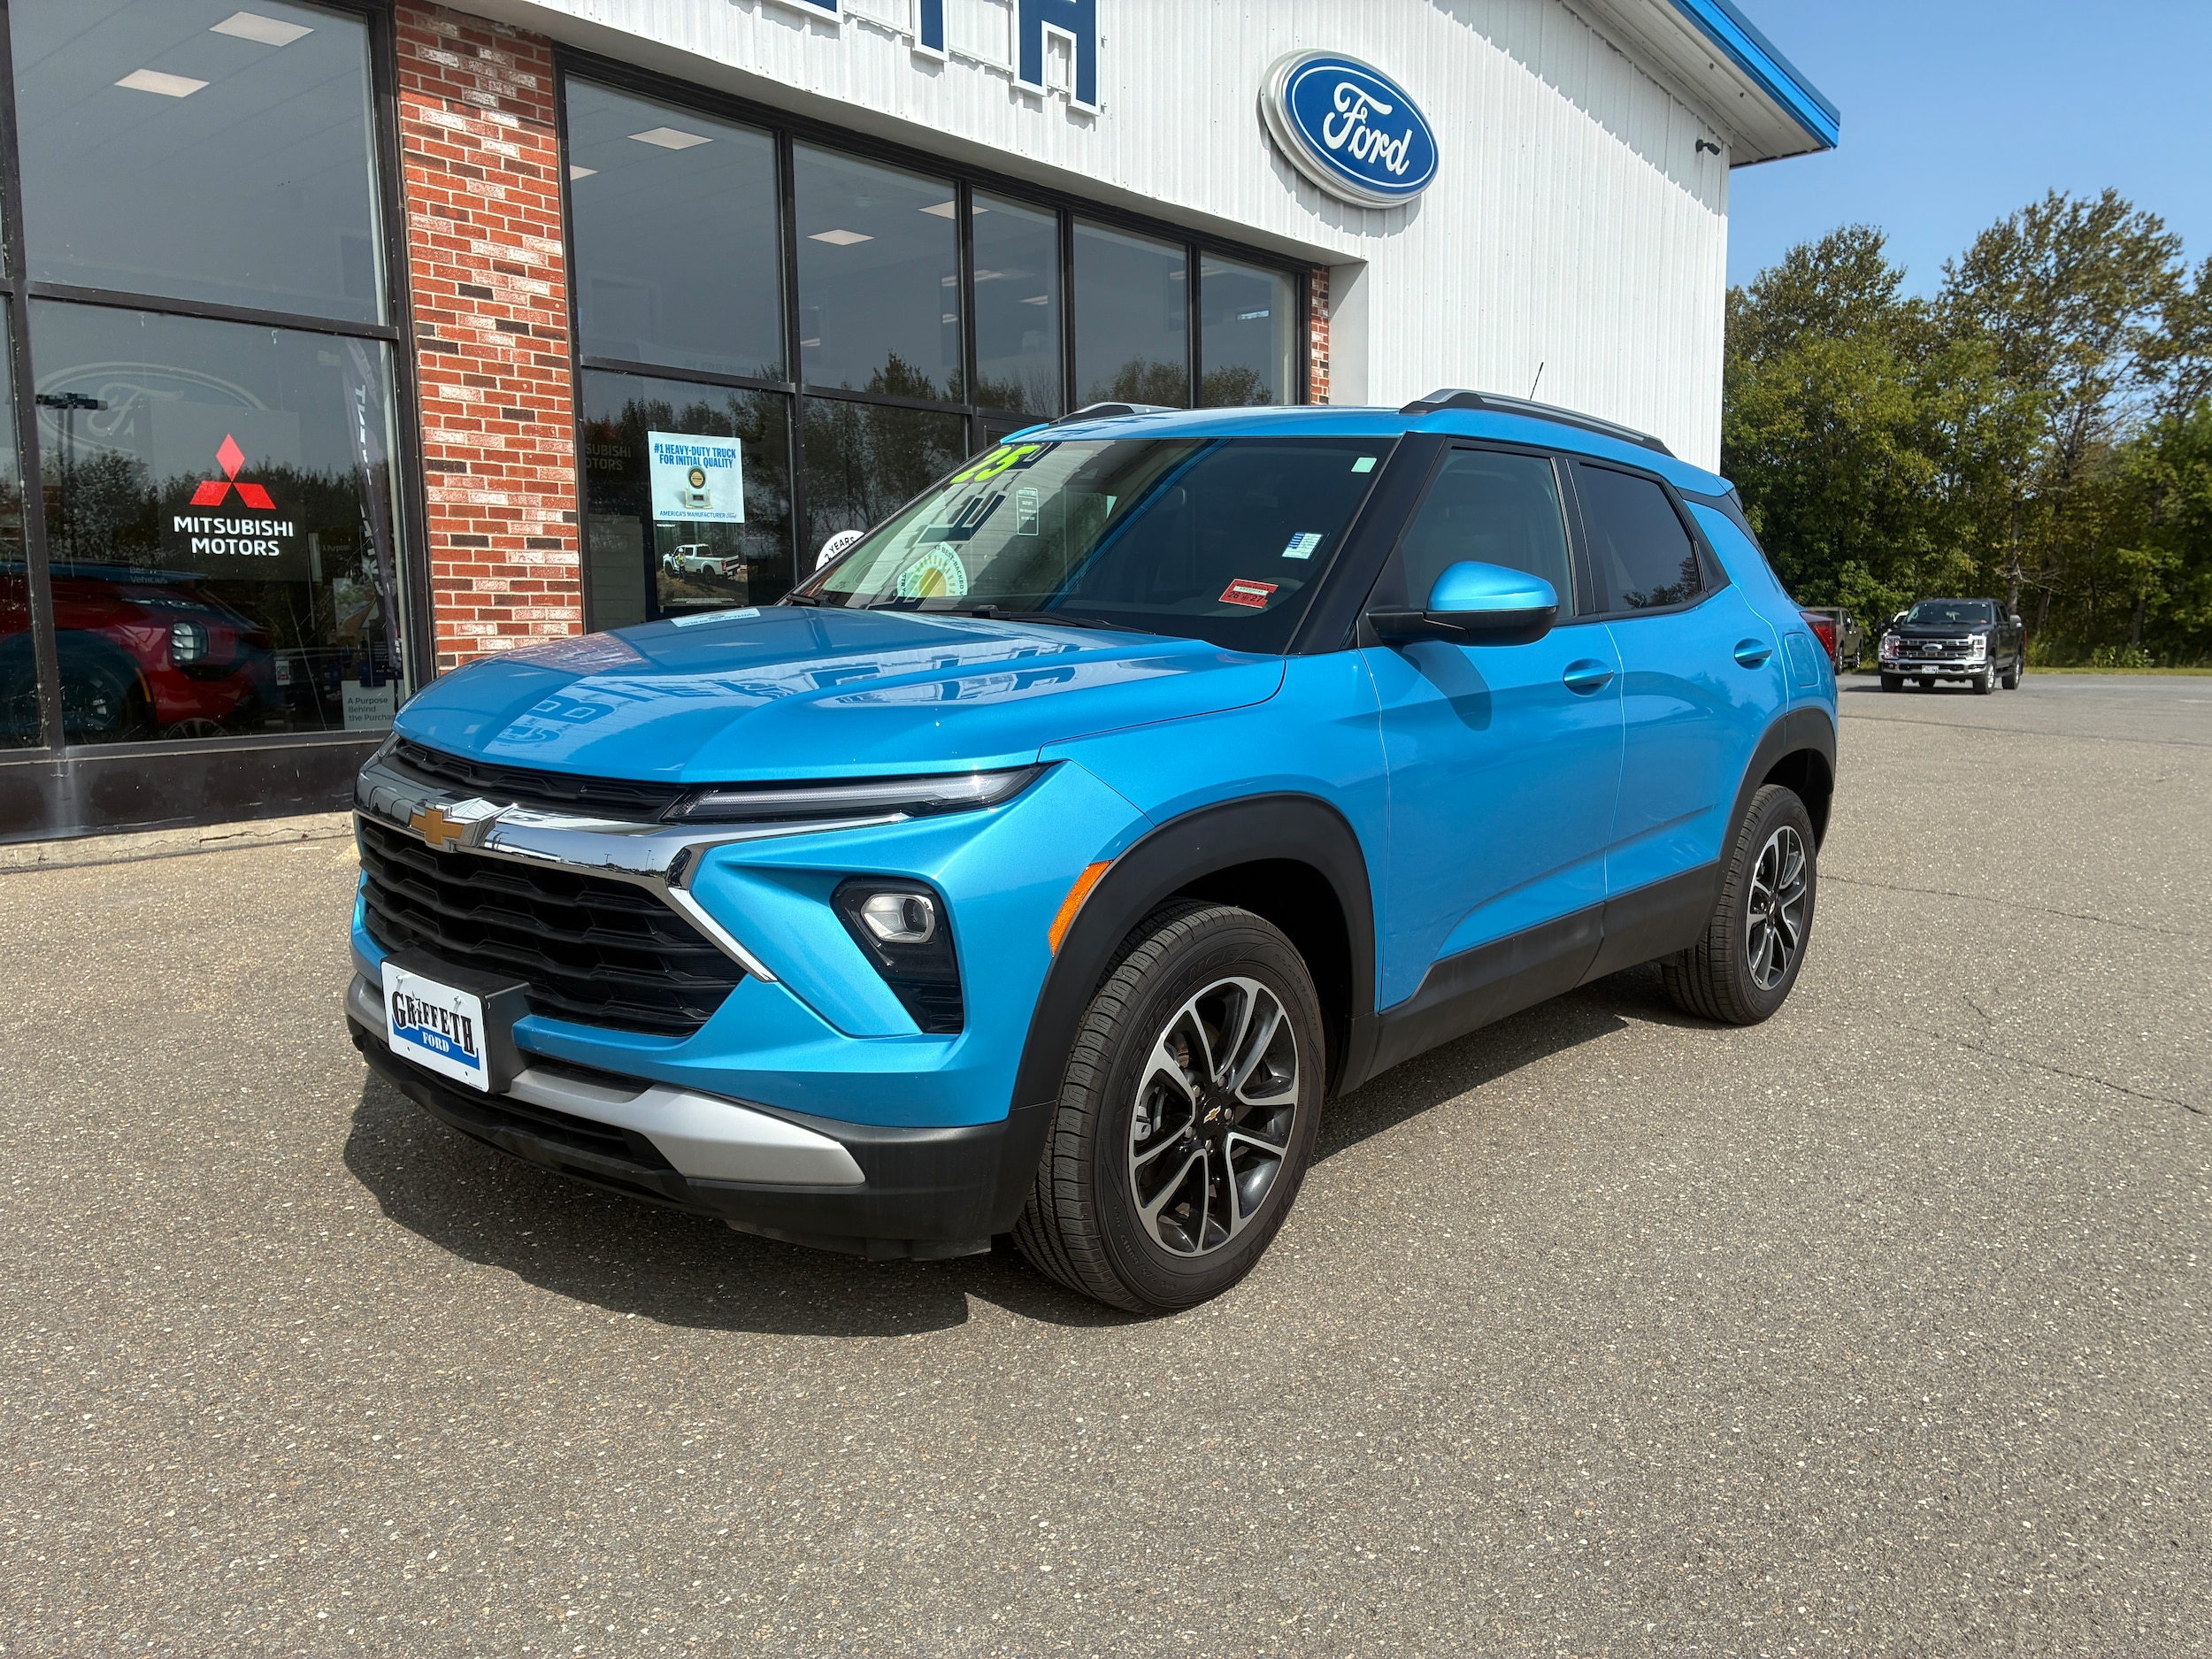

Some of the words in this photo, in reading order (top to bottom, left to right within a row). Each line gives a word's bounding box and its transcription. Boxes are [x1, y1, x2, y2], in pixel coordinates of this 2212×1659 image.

[1322, 81, 1413, 176] Ford
[654, 443, 664, 454] #1
[664, 444, 710, 457] HEAVY-DUTY
[711, 448, 736, 459] TRUCK
[659, 454, 674, 465] FOR
[675, 455, 702, 467] INITIAL
[703, 457, 733, 469] QUALITY
[173, 516, 294, 537] MITSUBISHI
[191, 537, 280, 557] MOTORS
[829, 536, 856, 554] YEARS
[391, 990, 475, 1056] GRIFFETH
[422, 1031, 450, 1053] FORD
